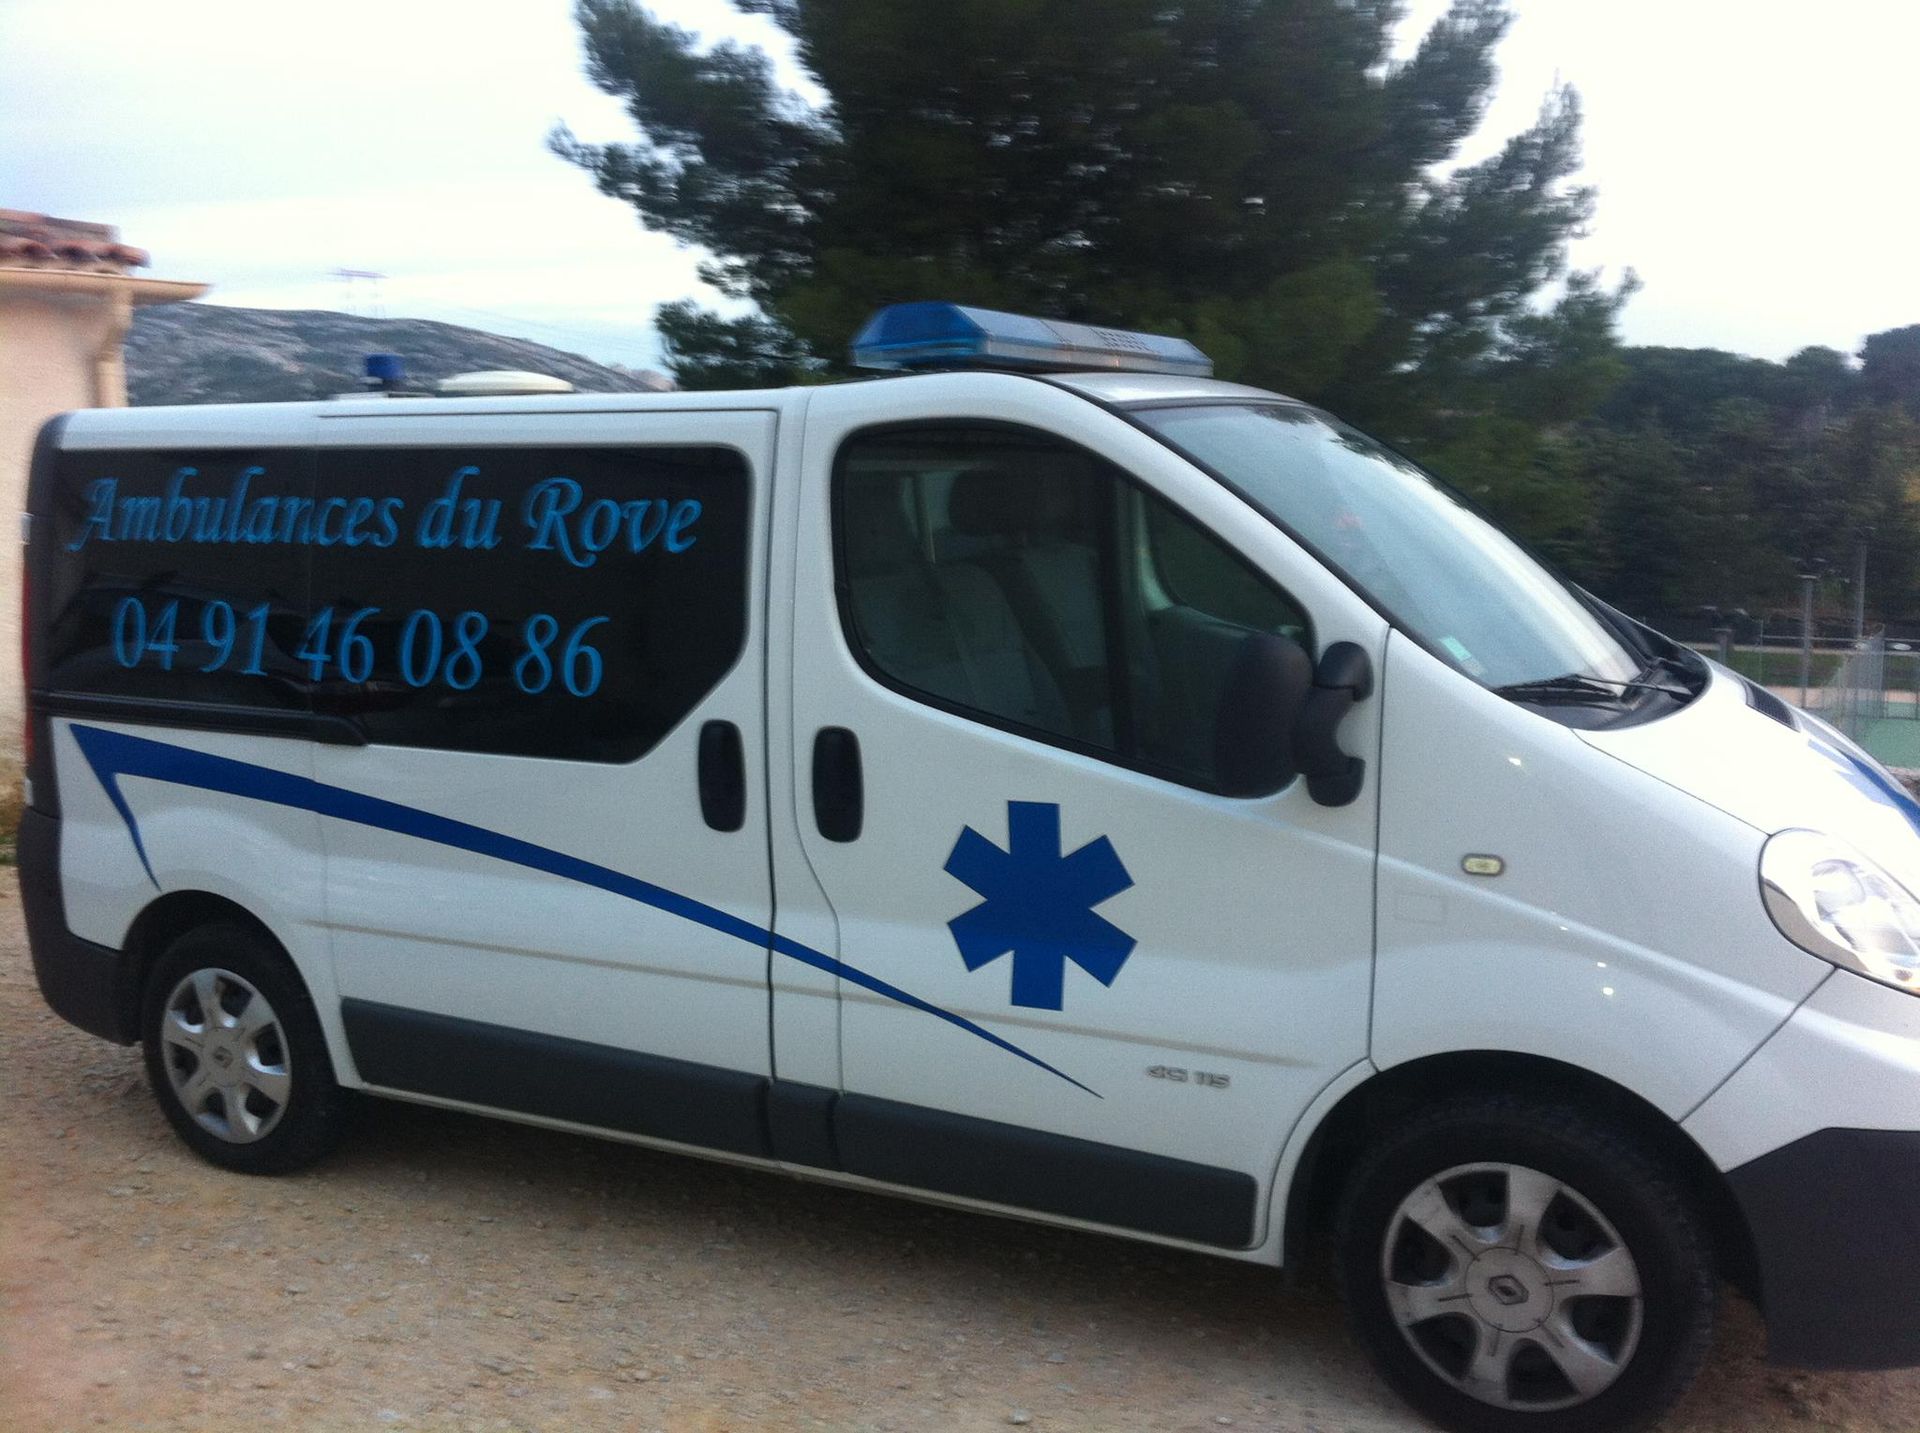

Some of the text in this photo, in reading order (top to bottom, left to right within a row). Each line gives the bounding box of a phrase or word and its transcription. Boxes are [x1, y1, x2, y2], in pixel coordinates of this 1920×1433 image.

[70, 466, 702, 567] Ambulances du Rove
[112, 598, 610, 698] 04 91 46 08 86
